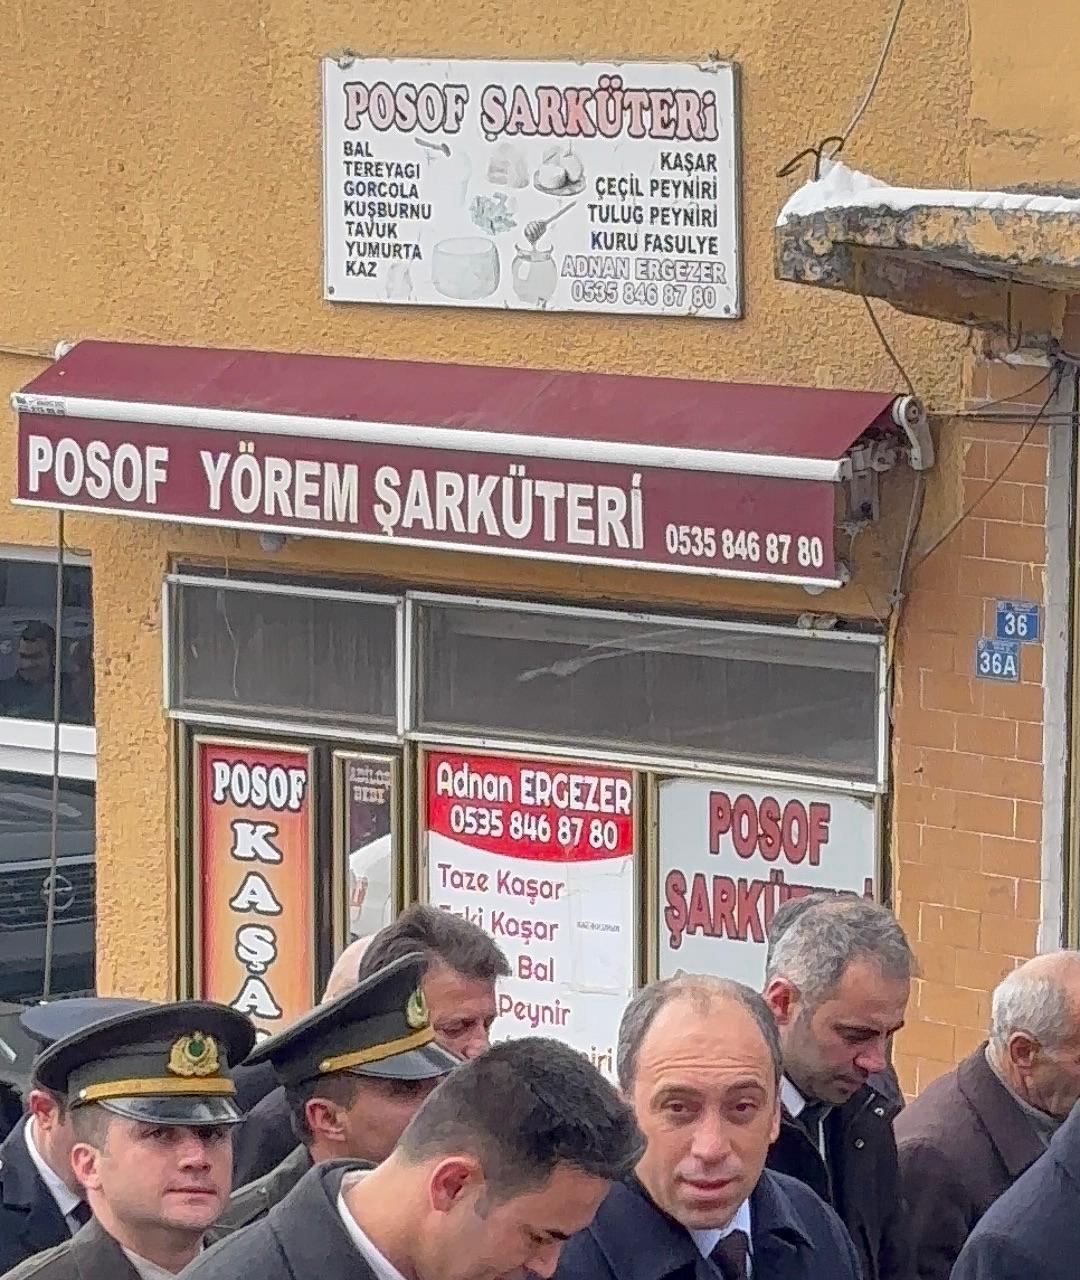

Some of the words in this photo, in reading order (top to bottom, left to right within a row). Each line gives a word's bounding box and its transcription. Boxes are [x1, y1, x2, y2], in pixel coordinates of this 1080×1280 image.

[343, 81, 469, 134] POSOF
[343, 141, 373, 157] BAL
[660, 152, 718, 177] KAŞAR
[595, 173, 644, 202] ÇEÇİL
[650, 176, 718, 200] PEYNİRİ
[344, 200, 432, 222] KUŞBURNU
[650, 203, 718, 227] PEYNİRİ
[345, 221, 397, 239] TAVUK
[591, 231, 638, 251] KURU
[644, 234, 718, 255] FASULYE
[345, 240, 422, 260] YUMURTA
[346, 261, 377, 277] KAZ
[561, 255, 630, 280] ADNAN
[635, 258, 727, 284] ERGEZER
[572, 280, 618, 304] 0535
[623, 282, 658, 306] 846
[663, 284, 687, 307] 87
[692, 286, 716, 309] 80
[28, 435, 169, 504] POSOF
[200, 440, 359, 524] YÖREM
[373, 464, 644, 549] ŞARKÜTERİ
[665, 522, 716, 558] 0535
[721, 527, 761, 562] 846
[766, 532, 790, 564] 87
[797, 535, 824, 568] 80
[1005, 612, 1027, 636] 36
[980, 651, 1016, 676] 36A
[211, 759, 306, 812] POSOF
[436, 761, 513, 803] Adnan
[520, 769, 632, 815] ERGEZER
[450, 805, 504, 838] 0535
[509, 810, 551, 843] 846
[557, 815, 584, 846] 87
[588, 818, 618, 850] 80
[709, 790, 831, 866] POSOF
[438, 863, 489, 893] Taze
[497, 869, 565, 905] Kaşar
[664, 868, 873, 950] ŞARKÜ
[229, 819, 283, 1044] KAŞA
[492, 910, 559, 945] Kaşar
[518, 955, 554, 982] Bal
[499, 994, 571, 1029] Peynir
